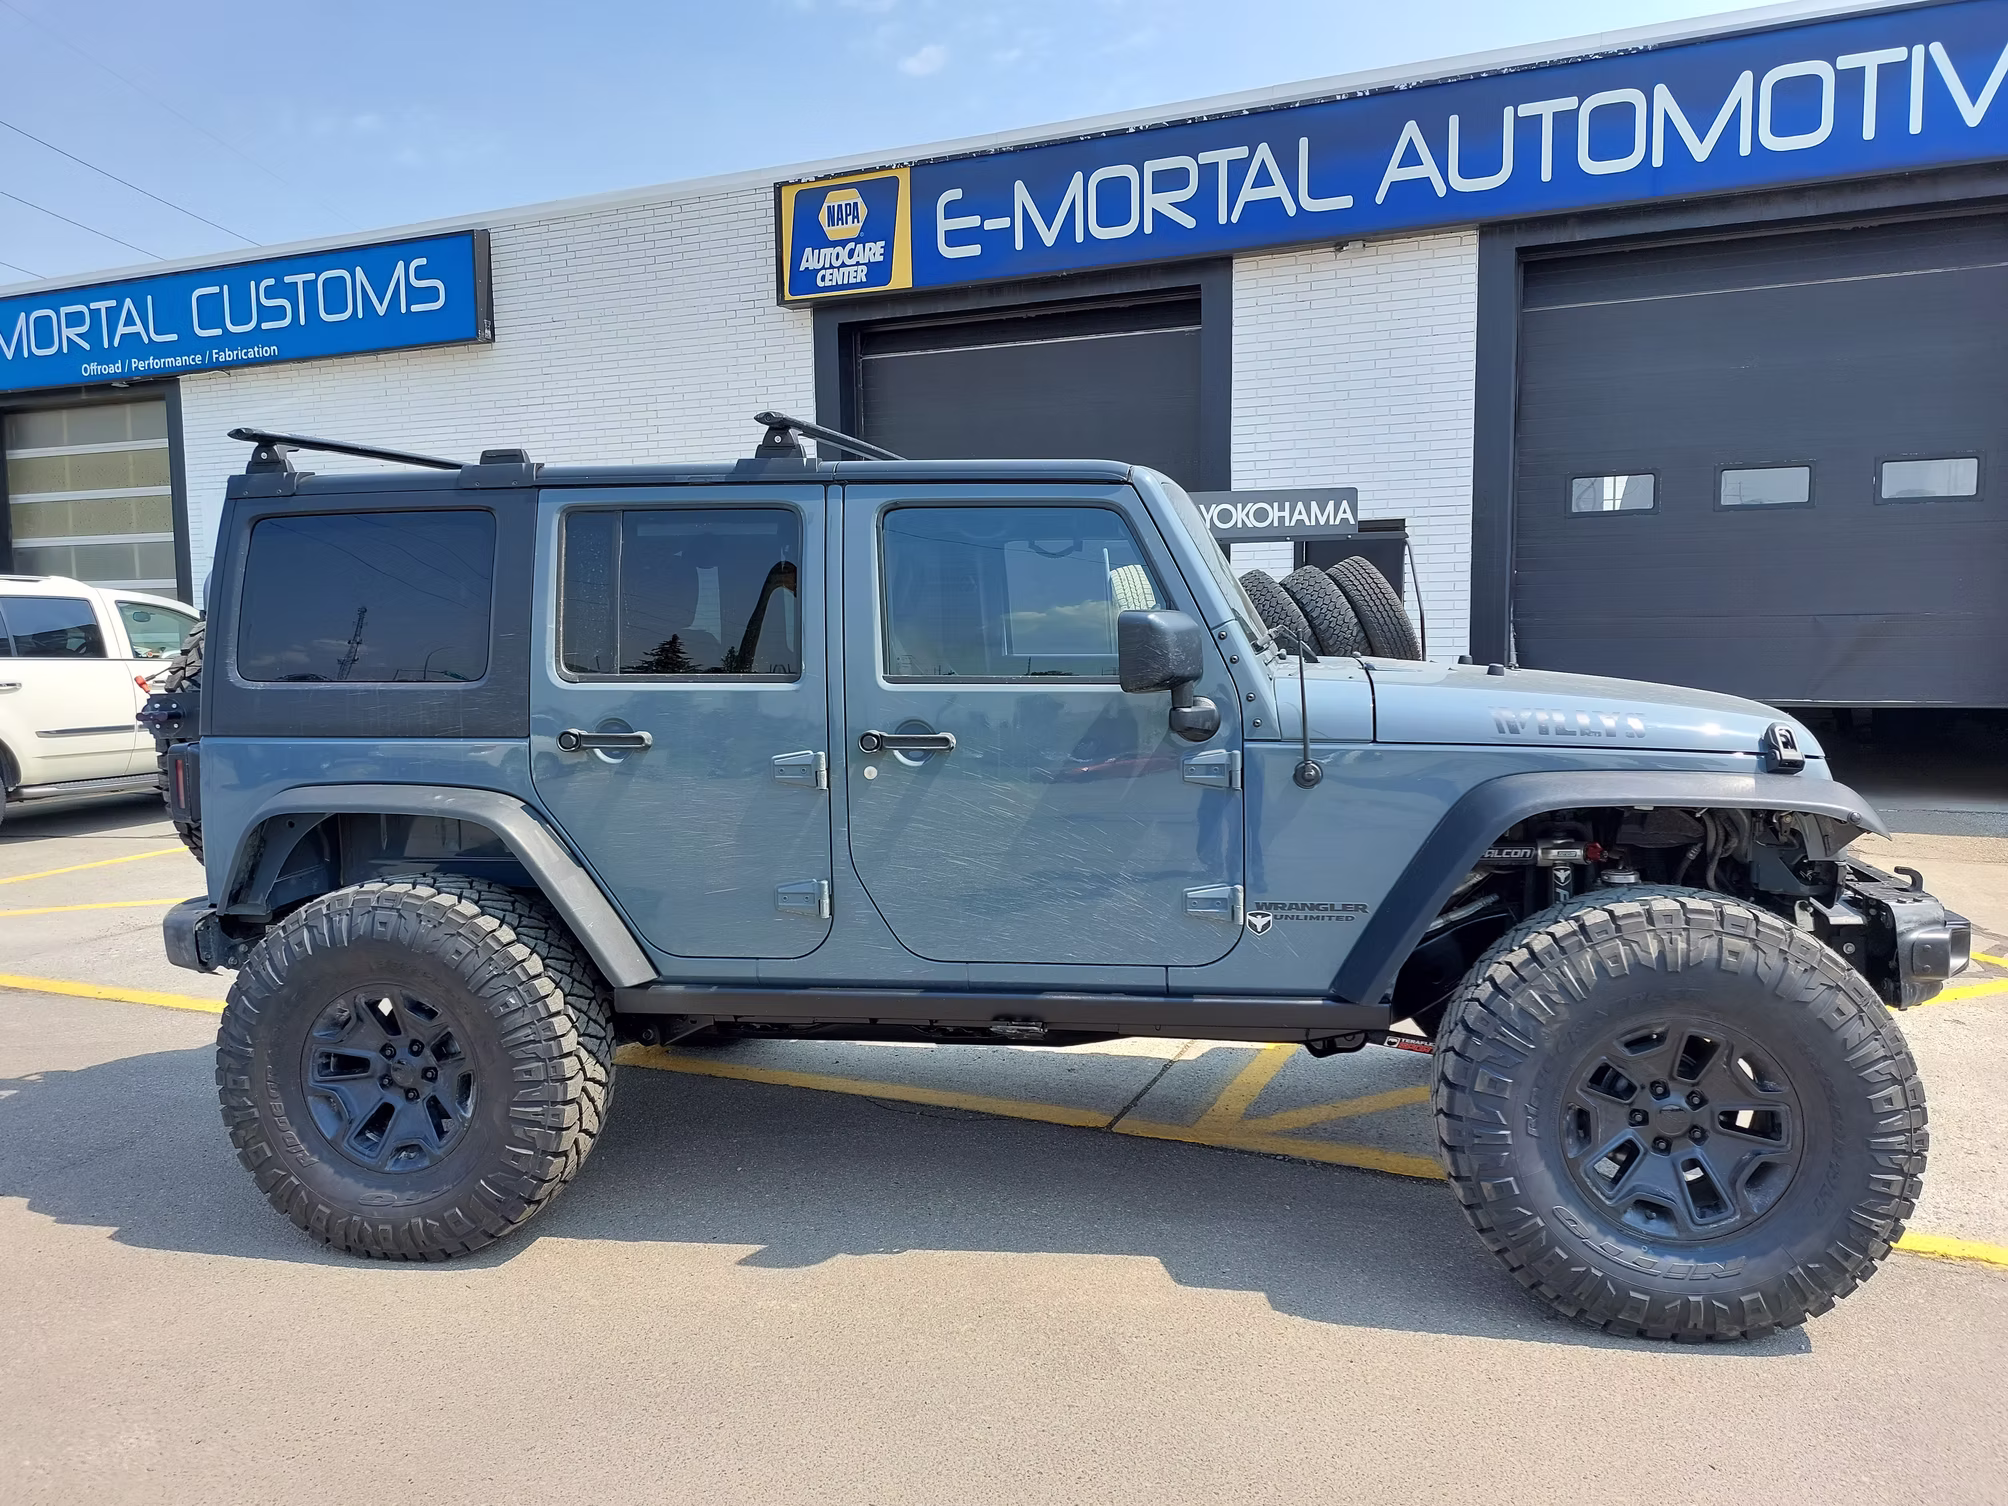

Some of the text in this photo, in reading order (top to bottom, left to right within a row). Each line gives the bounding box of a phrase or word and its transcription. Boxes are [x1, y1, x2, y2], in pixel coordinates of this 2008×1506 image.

[936, 41, 2008, 260] E-MORTAL AUTOMOTIV
[826, 201, 860, 228] NAPA
[816, 265, 868, 287] CENTER
[192, 257, 446, 337] CUSTOMS
[82, 359, 122, 376] Offroad
[132, 352, 202, 371] Performance
[212, 344, 278, 362] Fabrication
[1198, 499, 1356, 529] YOKOHAMA
[1484, 849, 1531, 858] ALCON
[1254, 901, 1370, 914] WRANGLER
[1273, 914, 1356, 922] UNLIMITED
